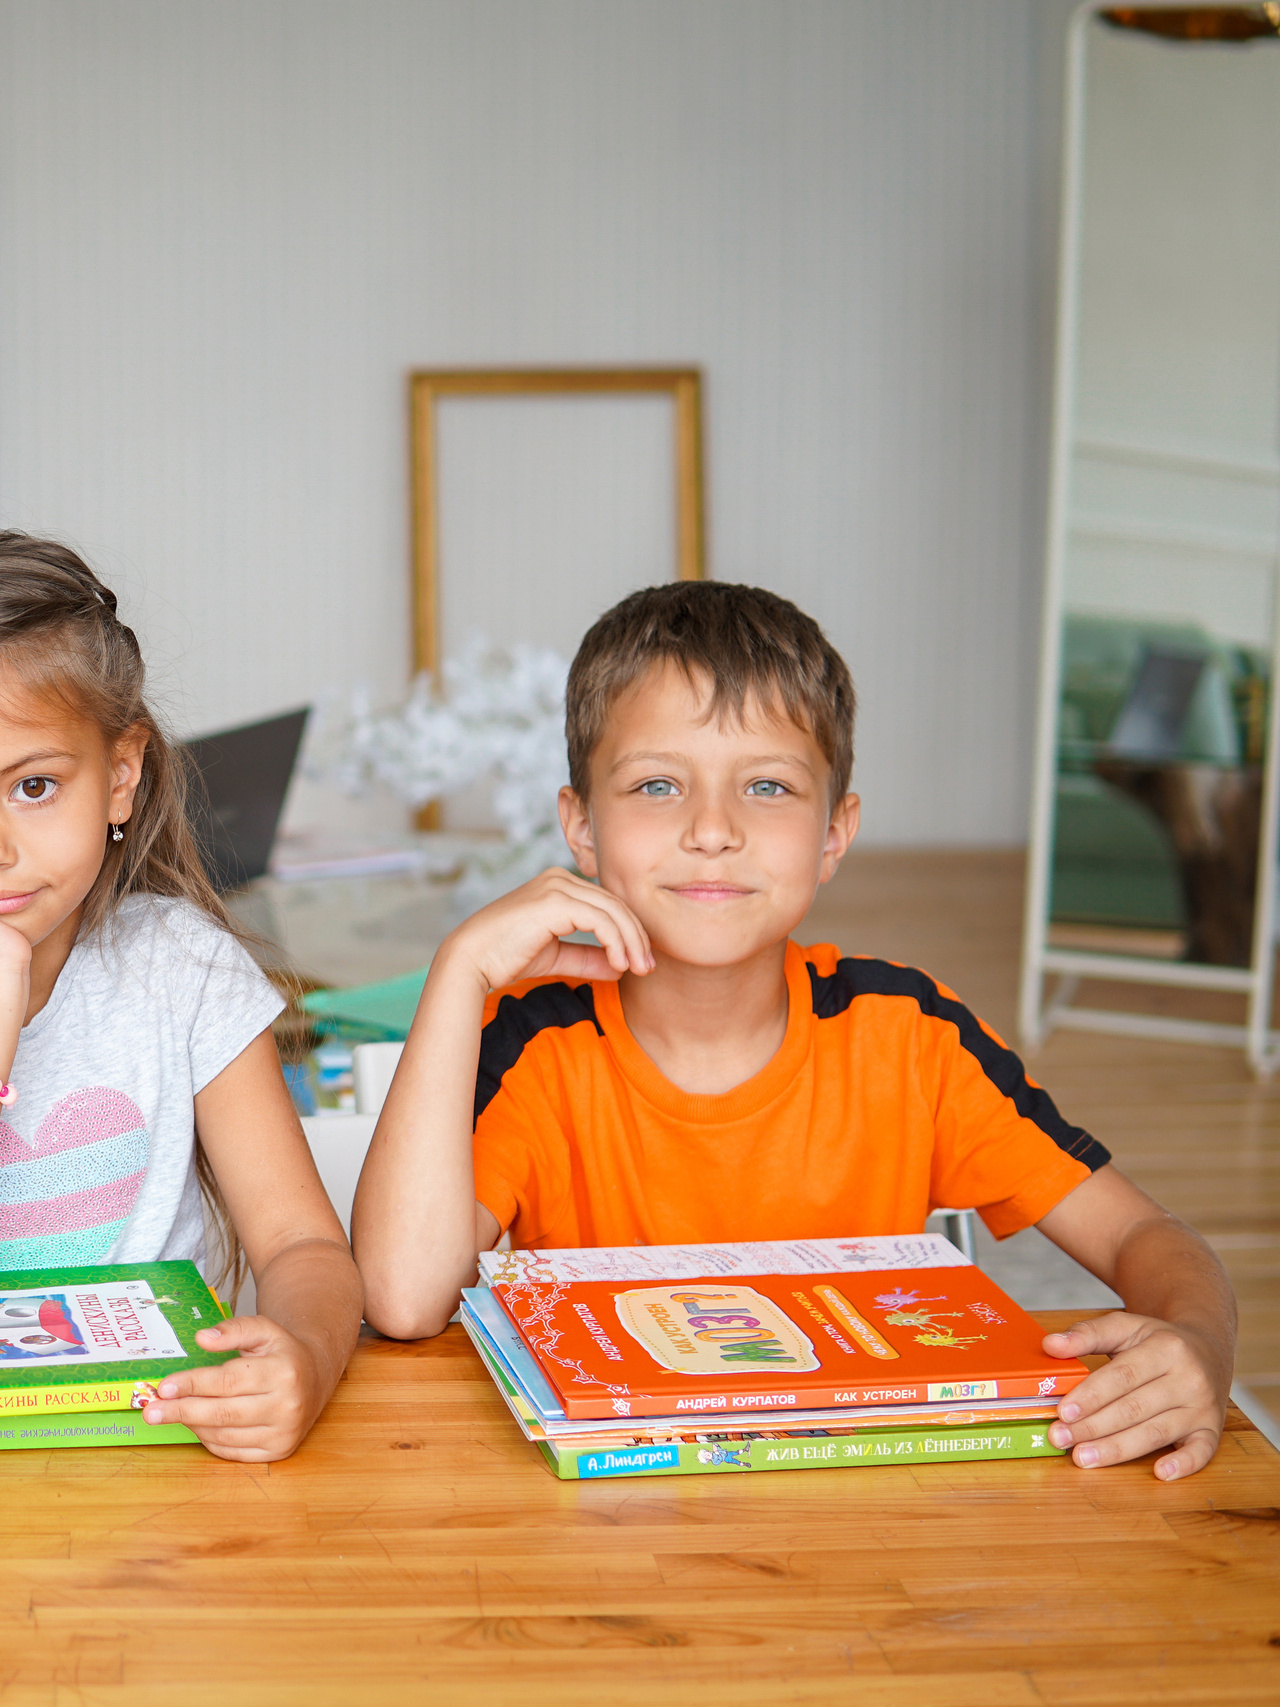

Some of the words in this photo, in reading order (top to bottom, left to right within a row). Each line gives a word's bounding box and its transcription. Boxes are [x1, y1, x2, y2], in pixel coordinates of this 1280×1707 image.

[75, 1293, 122, 1348] ДЕНИСКИНЫ
[107, 1296, 148, 1341] РАССКАЗЫ
[572, 1303, 606, 1335] КУРПАТОВ
[643, 1303, 686, 1338] УСТРОЕН
[670, 1292, 797, 1363] МОЗГ?
[591, 1335, 624, 1361] АНДРЕЙ
[670, 1338, 699, 1354] КАК
[44, 1390, 121, 1406] РАССКАЗЫ
[676, 1396, 727, 1409] АНДРЕЙ
[732, 1394, 796, 1408] КУРПАТОВ
[834, 1391, 858, 1402] КАК
[862, 1389, 917, 1401] УСТРОЕН
[19, 1422, 135, 1438] Нейропсихологические
[766, 1446, 799, 1462] ЖИВ
[803, 1444, 837, 1460] ЕЩЁ
[842, 1441, 891, 1457] ЭМИЛЬ
[895, 1441, 913, 1455] ИЗ
[915, 1436, 1012, 1454] ЛЁННЕБЕРГИ!
